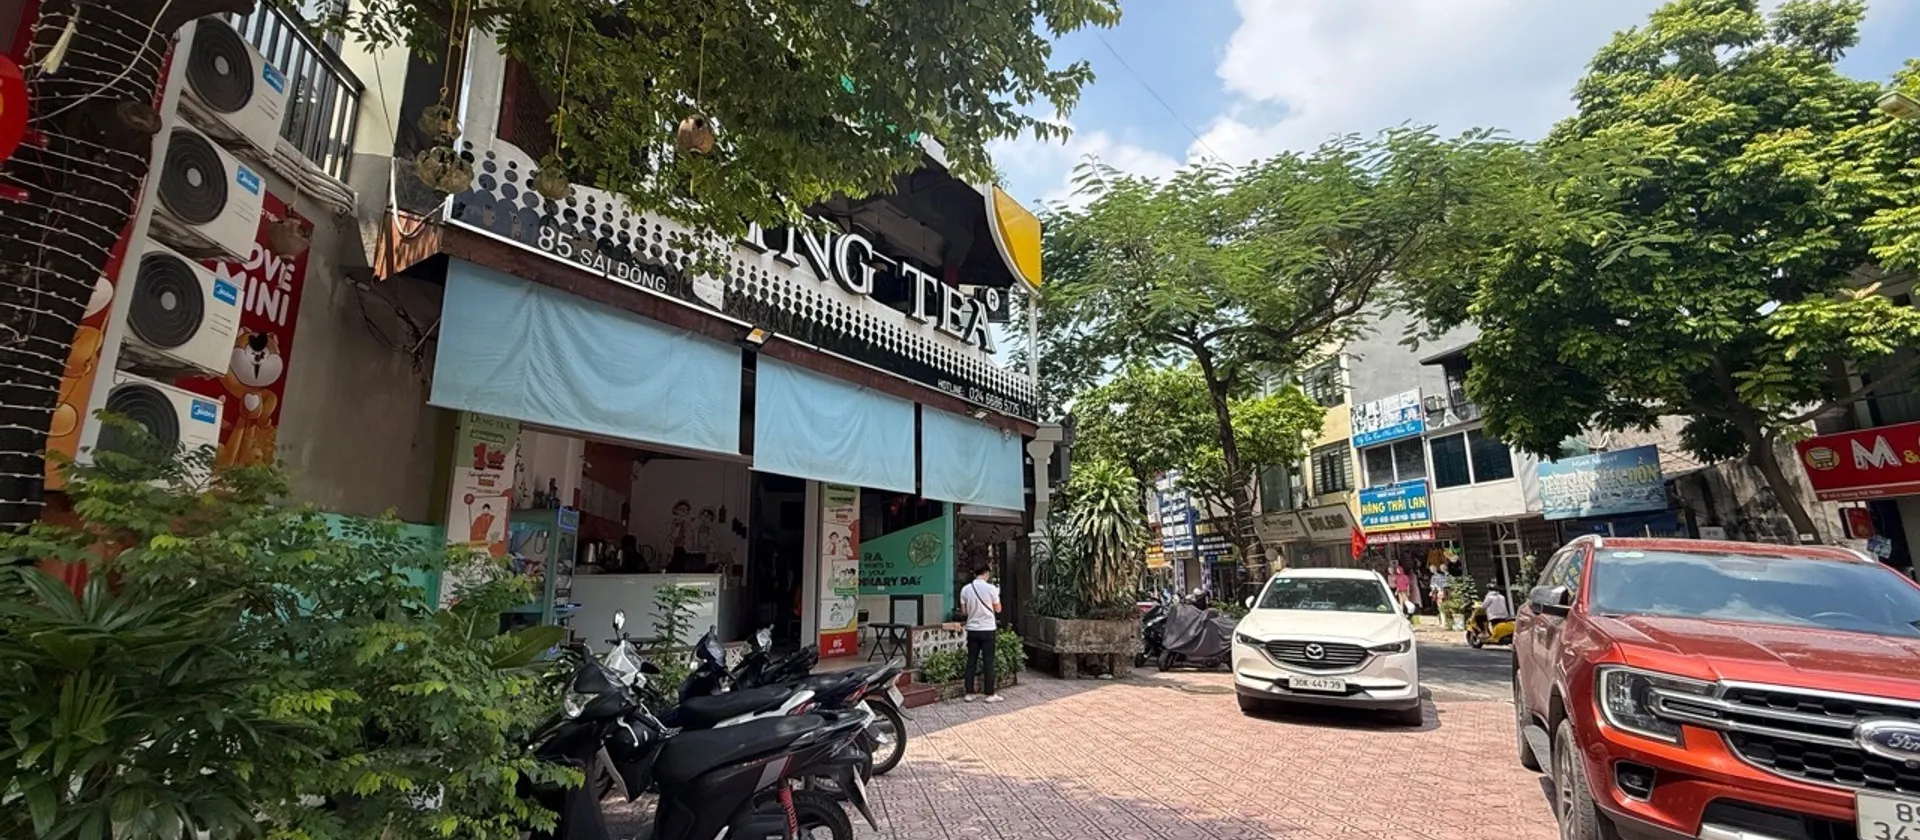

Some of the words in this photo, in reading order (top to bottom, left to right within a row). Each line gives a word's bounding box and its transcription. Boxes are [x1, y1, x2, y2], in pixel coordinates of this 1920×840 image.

[537, 225, 574, 258] 85
[241, 241, 296, 292] OVE
[1851, 435, 1901, 470] M
[1361, 501, 1386, 515] HÀNG
[1387, 497, 1407, 512] THÁI
[1408, 496, 1427, 510] LAN
